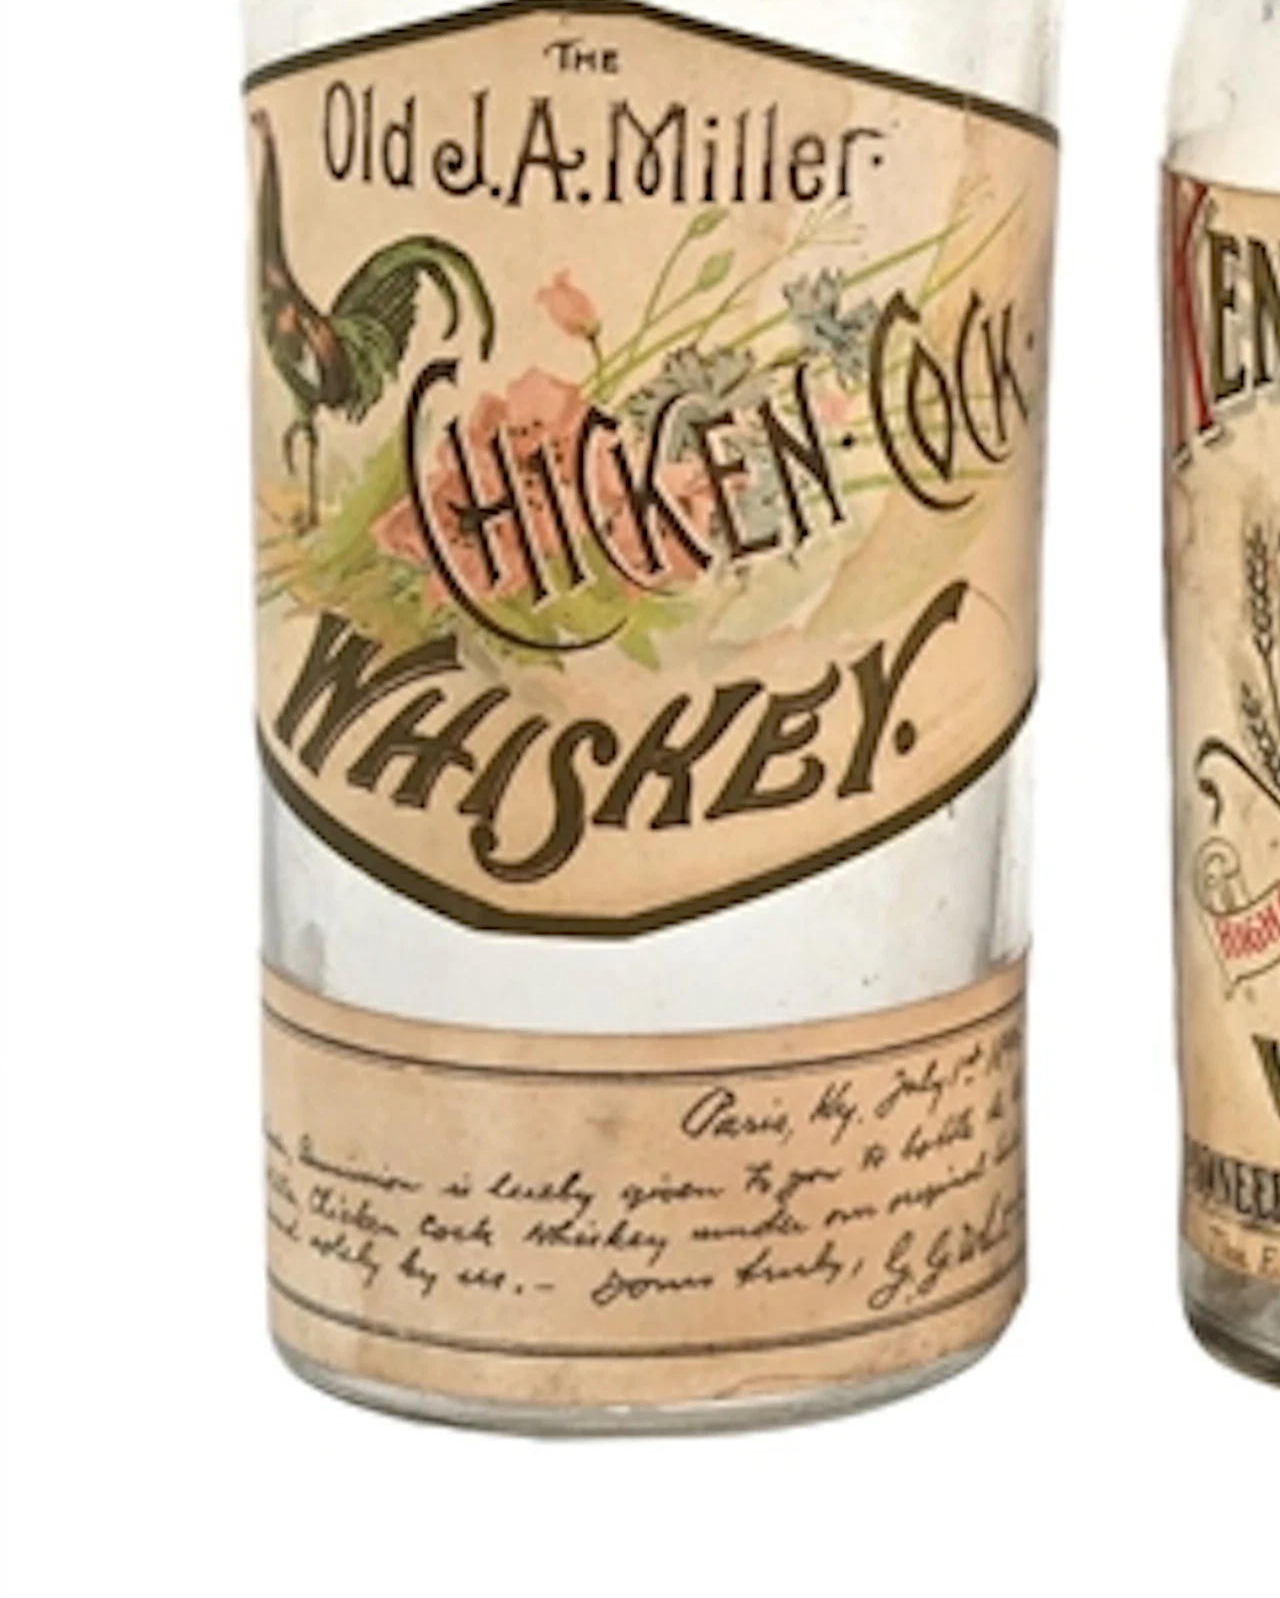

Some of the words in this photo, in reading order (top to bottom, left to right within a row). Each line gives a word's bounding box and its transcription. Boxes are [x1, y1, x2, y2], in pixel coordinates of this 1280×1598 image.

[544, 36, 620, 74] THE
[322, 79, 414, 188] Old
[405, 359, 846, 652] CHICKEN
